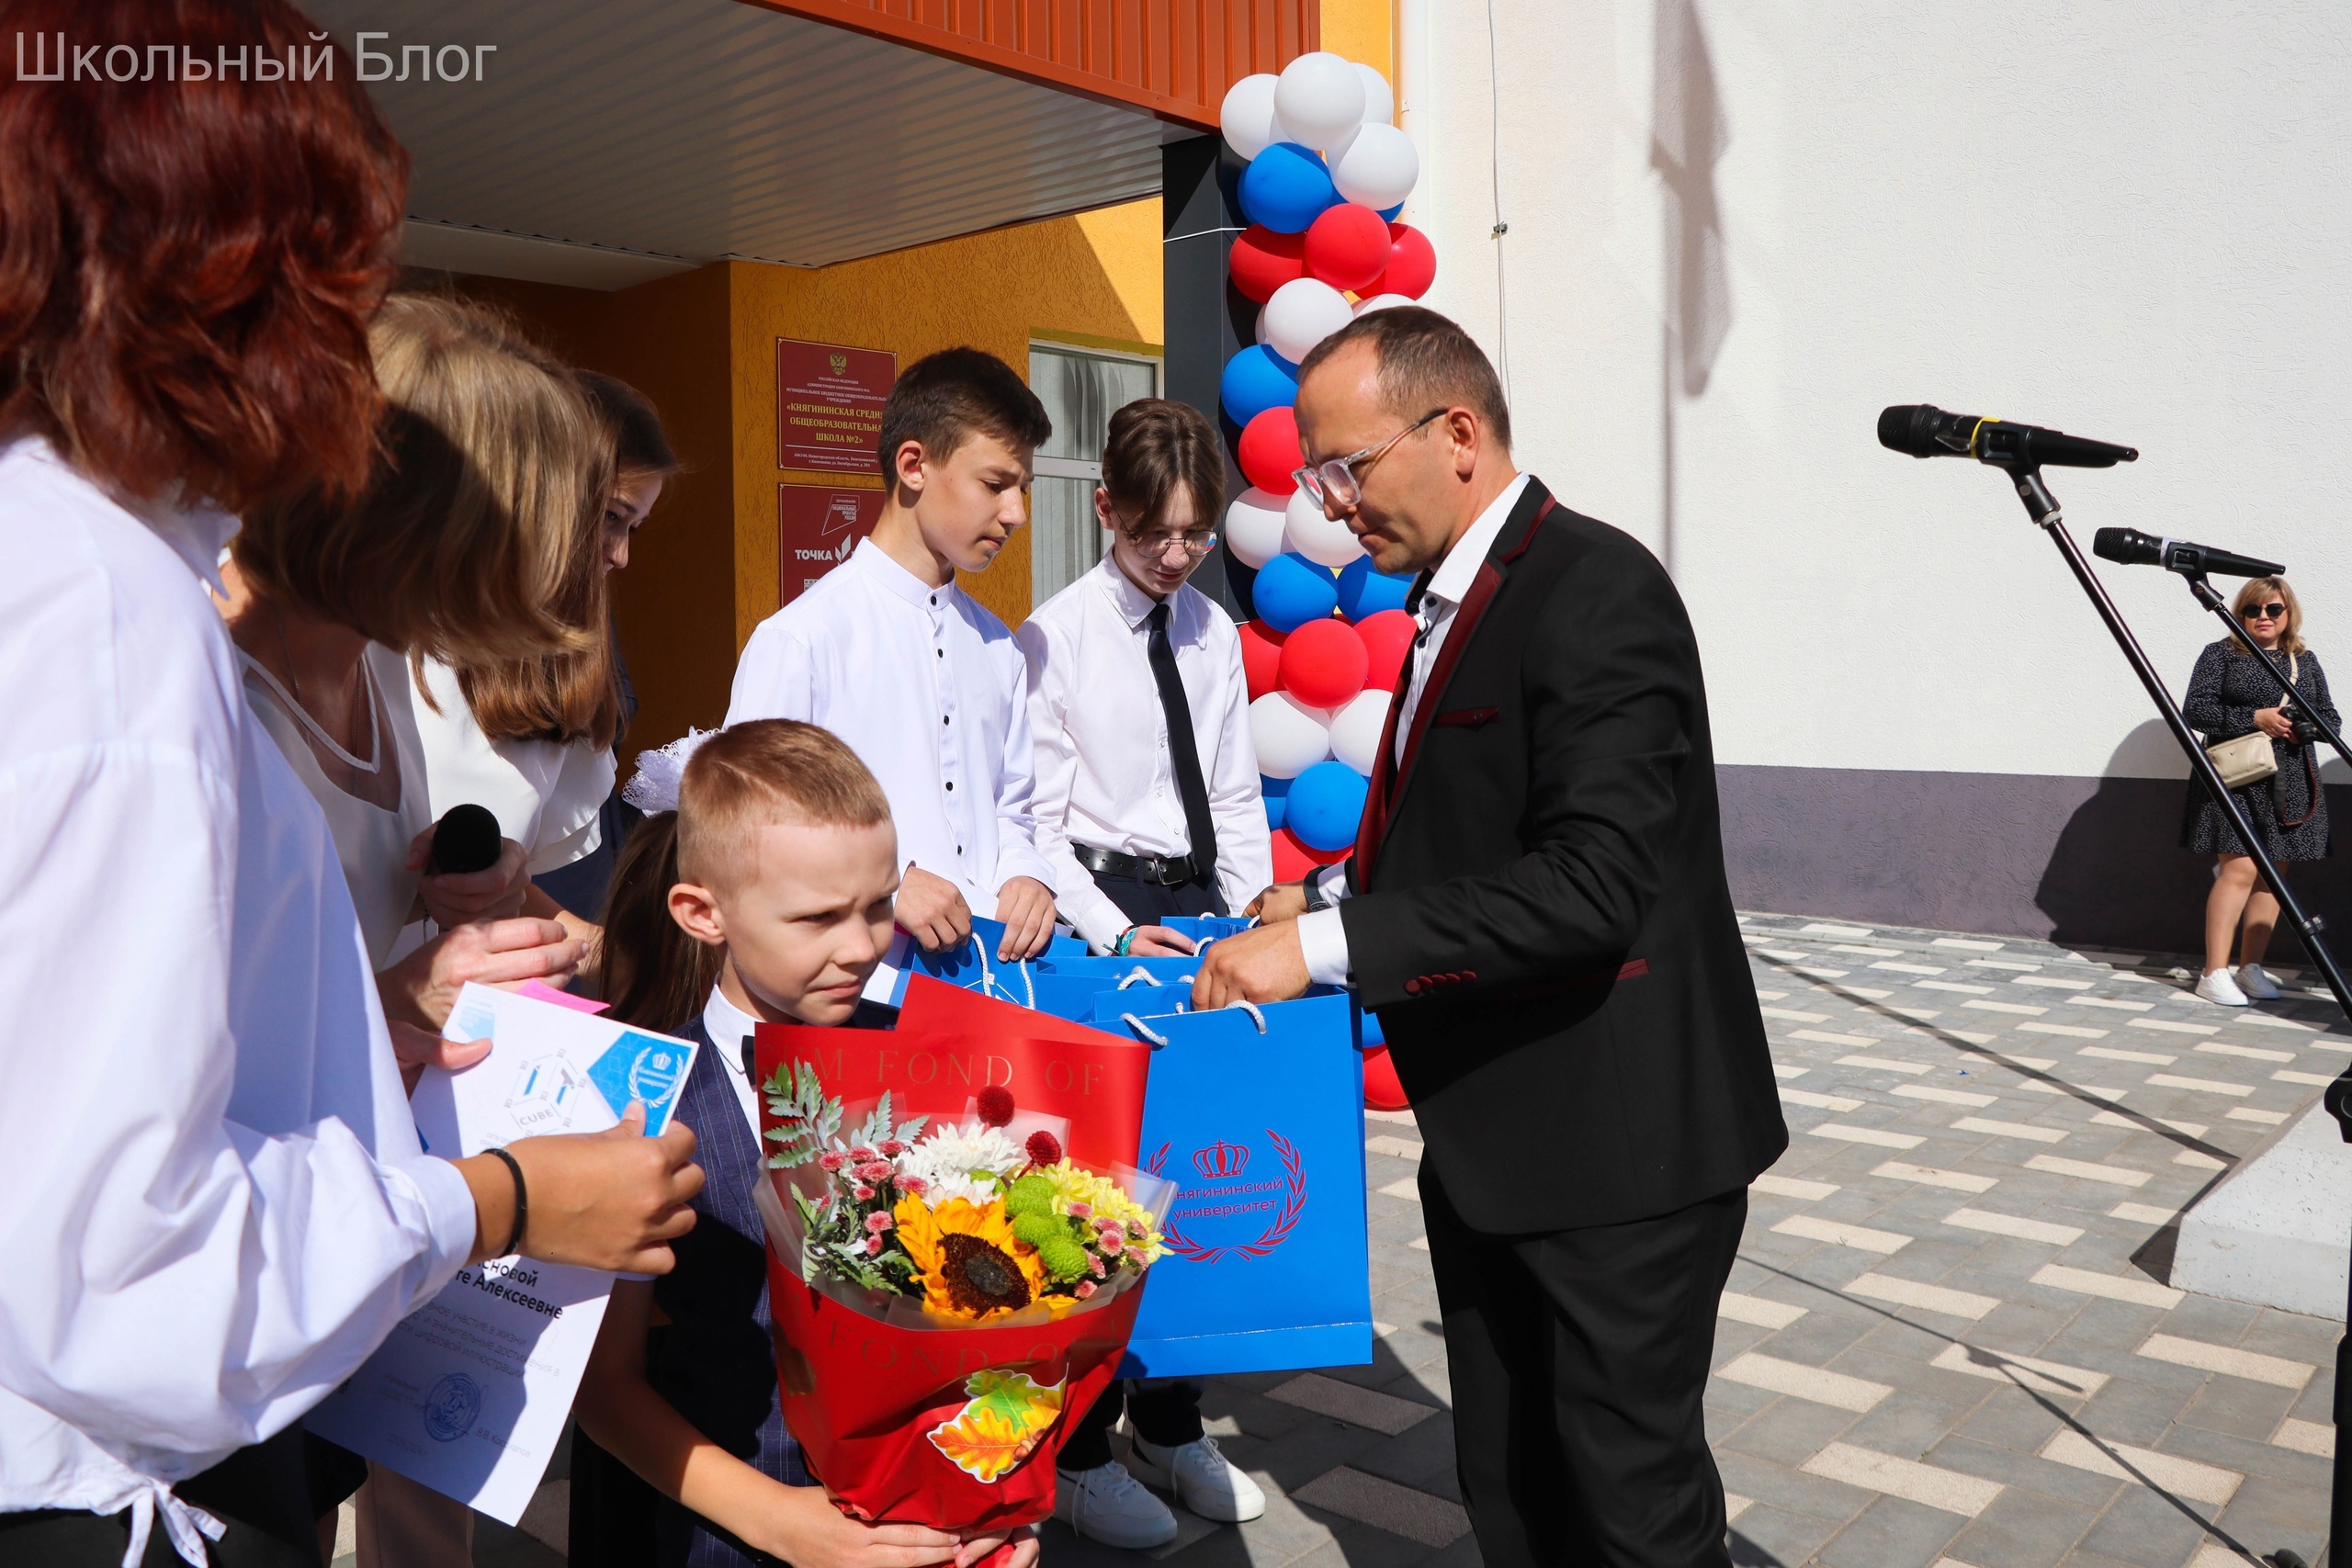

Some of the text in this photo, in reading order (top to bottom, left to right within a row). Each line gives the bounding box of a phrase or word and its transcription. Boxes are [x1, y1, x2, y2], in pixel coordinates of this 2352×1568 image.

[786, 403, 854, 417] «КНЯГИНИНСКАЯ
[790, 416, 883, 432] ОБЩЕОБРАЗОВАТЕЛЬНА
[816, 433, 864, 444] ШКОЛА №2»
[795, 549, 833, 560] ТОЧКА
[876, 1050, 1013, 1089] FOND
[1046, 1060, 1103, 1097] OF
[519, 1109, 554, 1125] CUBE
[1174, 1176, 1284, 1201] нягининский
[1172, 1199, 1278, 1223] университет
[478, 1259, 539, 1288] сновой
[472, 1272, 563, 1320] Алексеевне
[430, 1319, 494, 1350] значительные
[451, 1310, 488, 1332] участие
[496, 1329, 526, 1348] жизни
[830, 1319, 989, 1378] FOND
